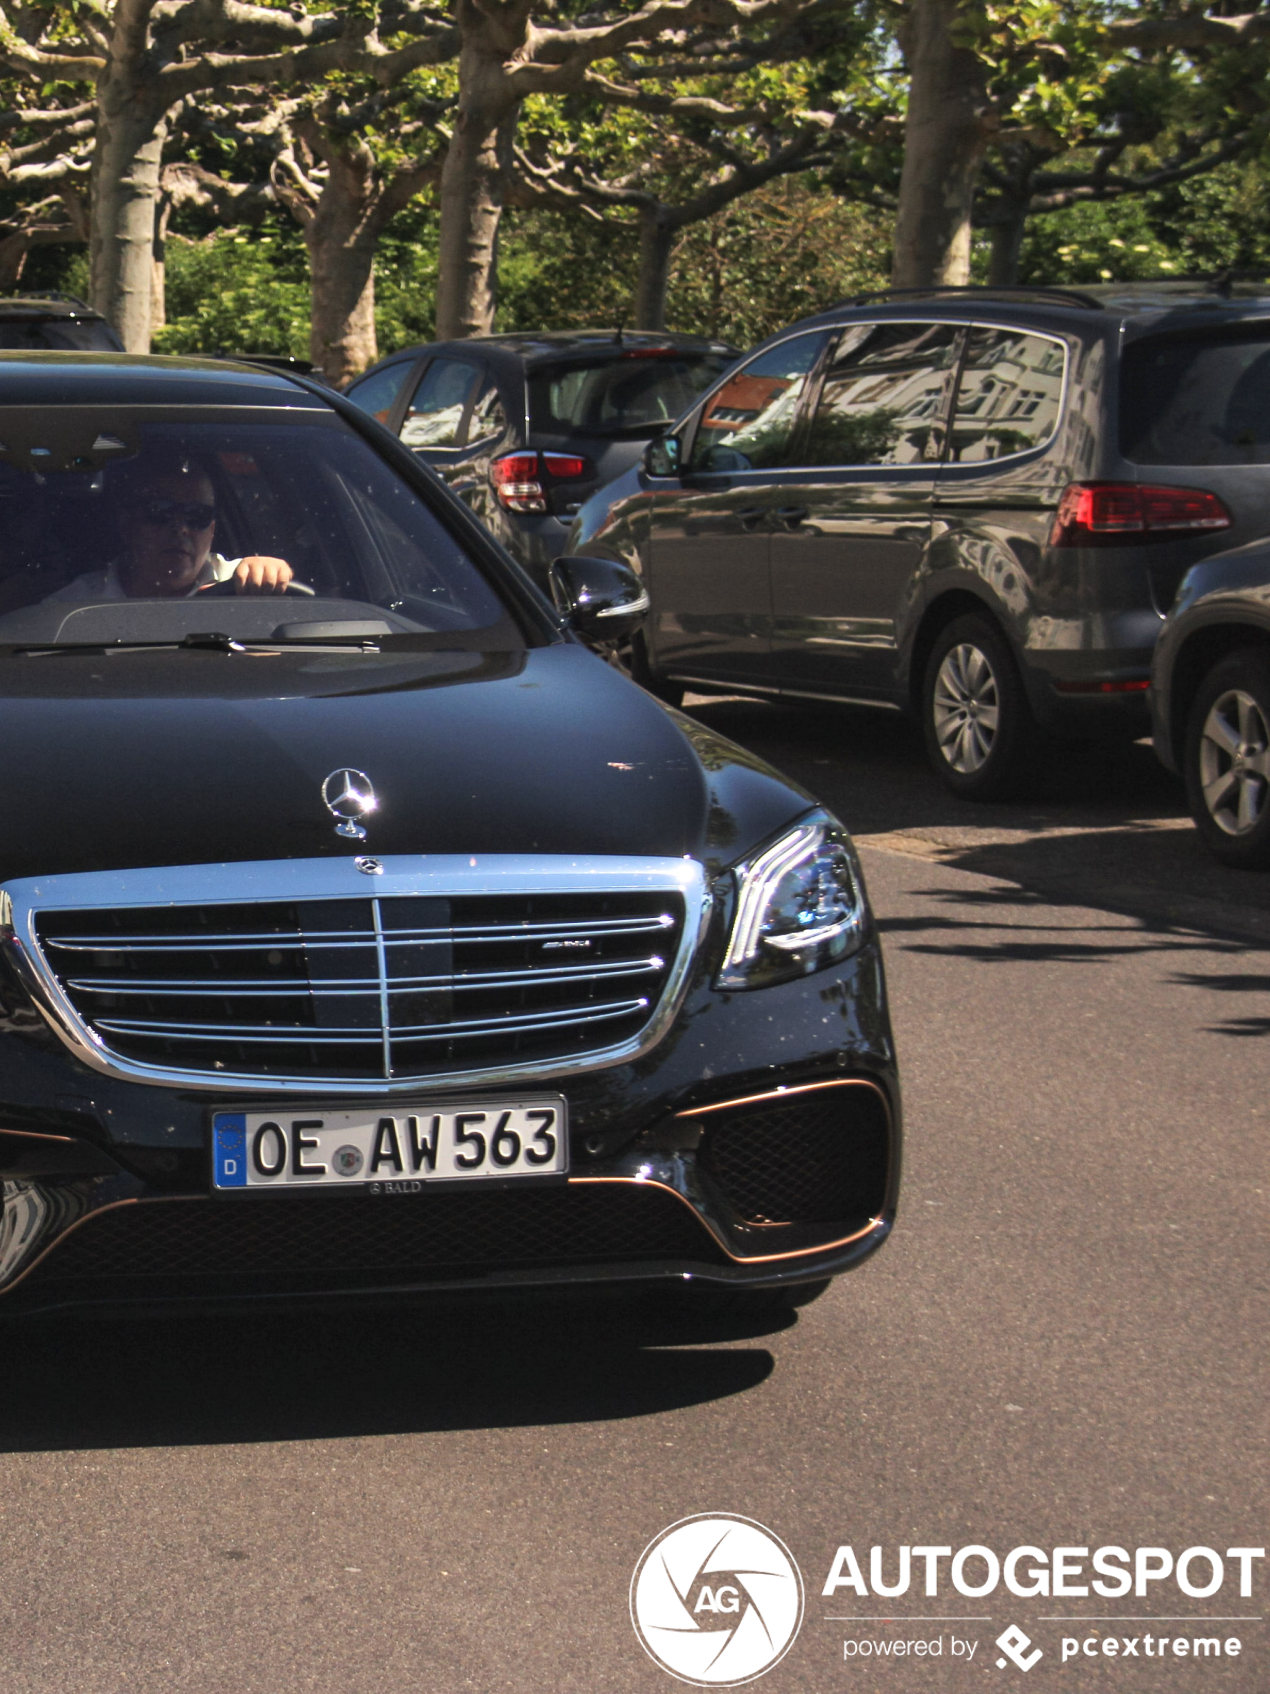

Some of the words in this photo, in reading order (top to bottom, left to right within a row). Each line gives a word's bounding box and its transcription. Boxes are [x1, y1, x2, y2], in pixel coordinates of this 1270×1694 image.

[251, 1119, 327, 1177] OE
[370, 1114, 441, 1173] AW
[455, 1107, 557, 1169] 563
[224, 1159, 237, 1175] D
[385, 1181, 422, 1194] BALD
